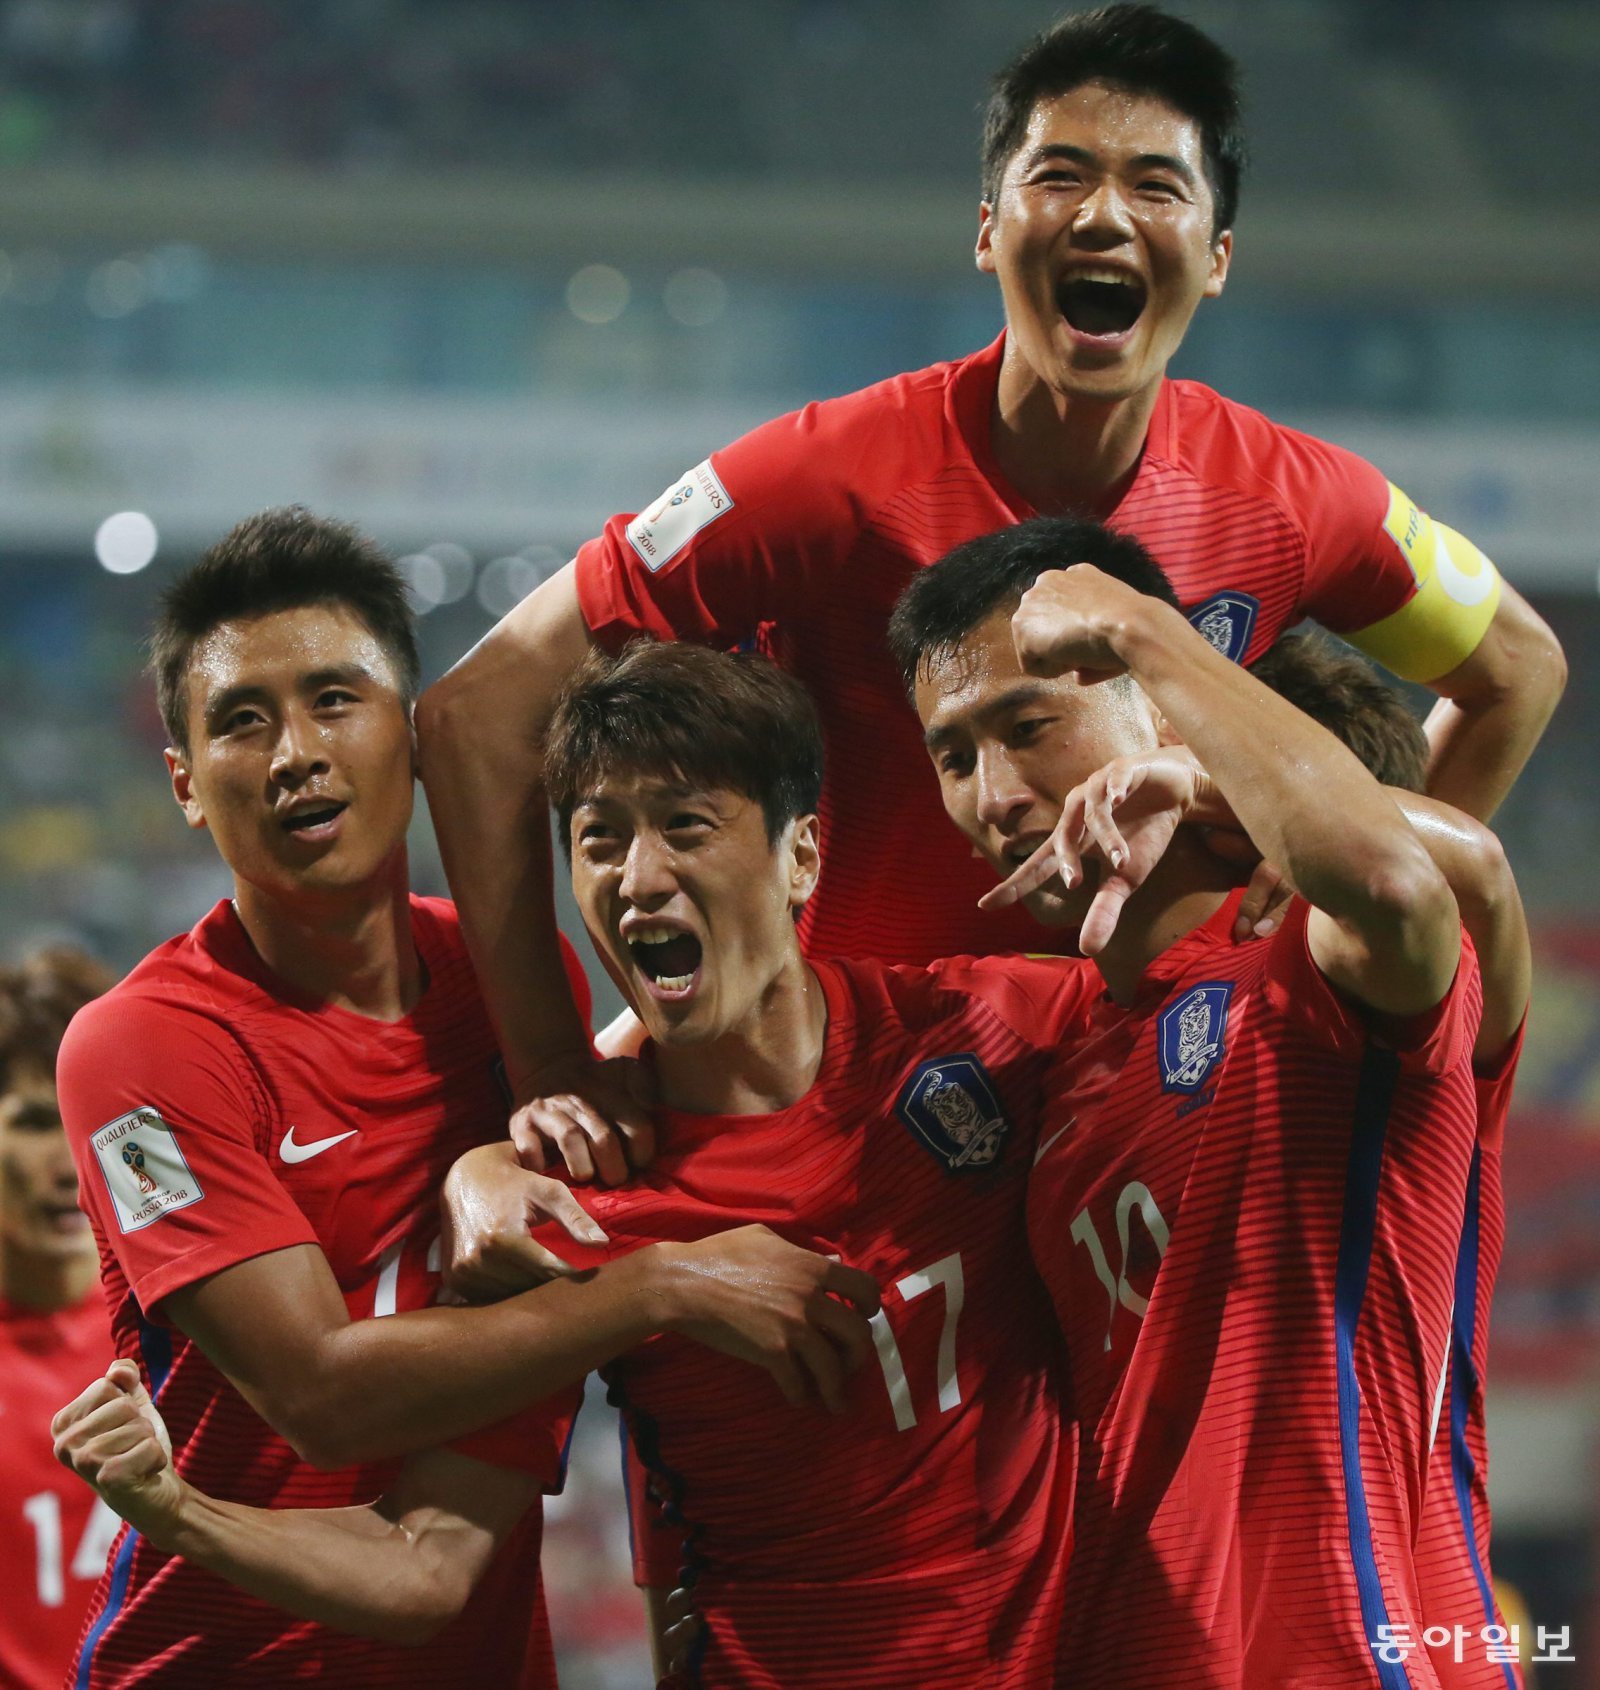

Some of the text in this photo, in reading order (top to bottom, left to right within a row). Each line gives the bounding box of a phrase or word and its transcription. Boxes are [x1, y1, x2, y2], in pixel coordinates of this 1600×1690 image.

[637, 533, 657, 556] 2018
[95, 1112, 155, 1151] QUALIFIERS
[132, 1189, 188, 1222] RUSSIA 2018
[1069, 1181, 1170, 1352] 10
[864, 1252, 965, 1431] 17
